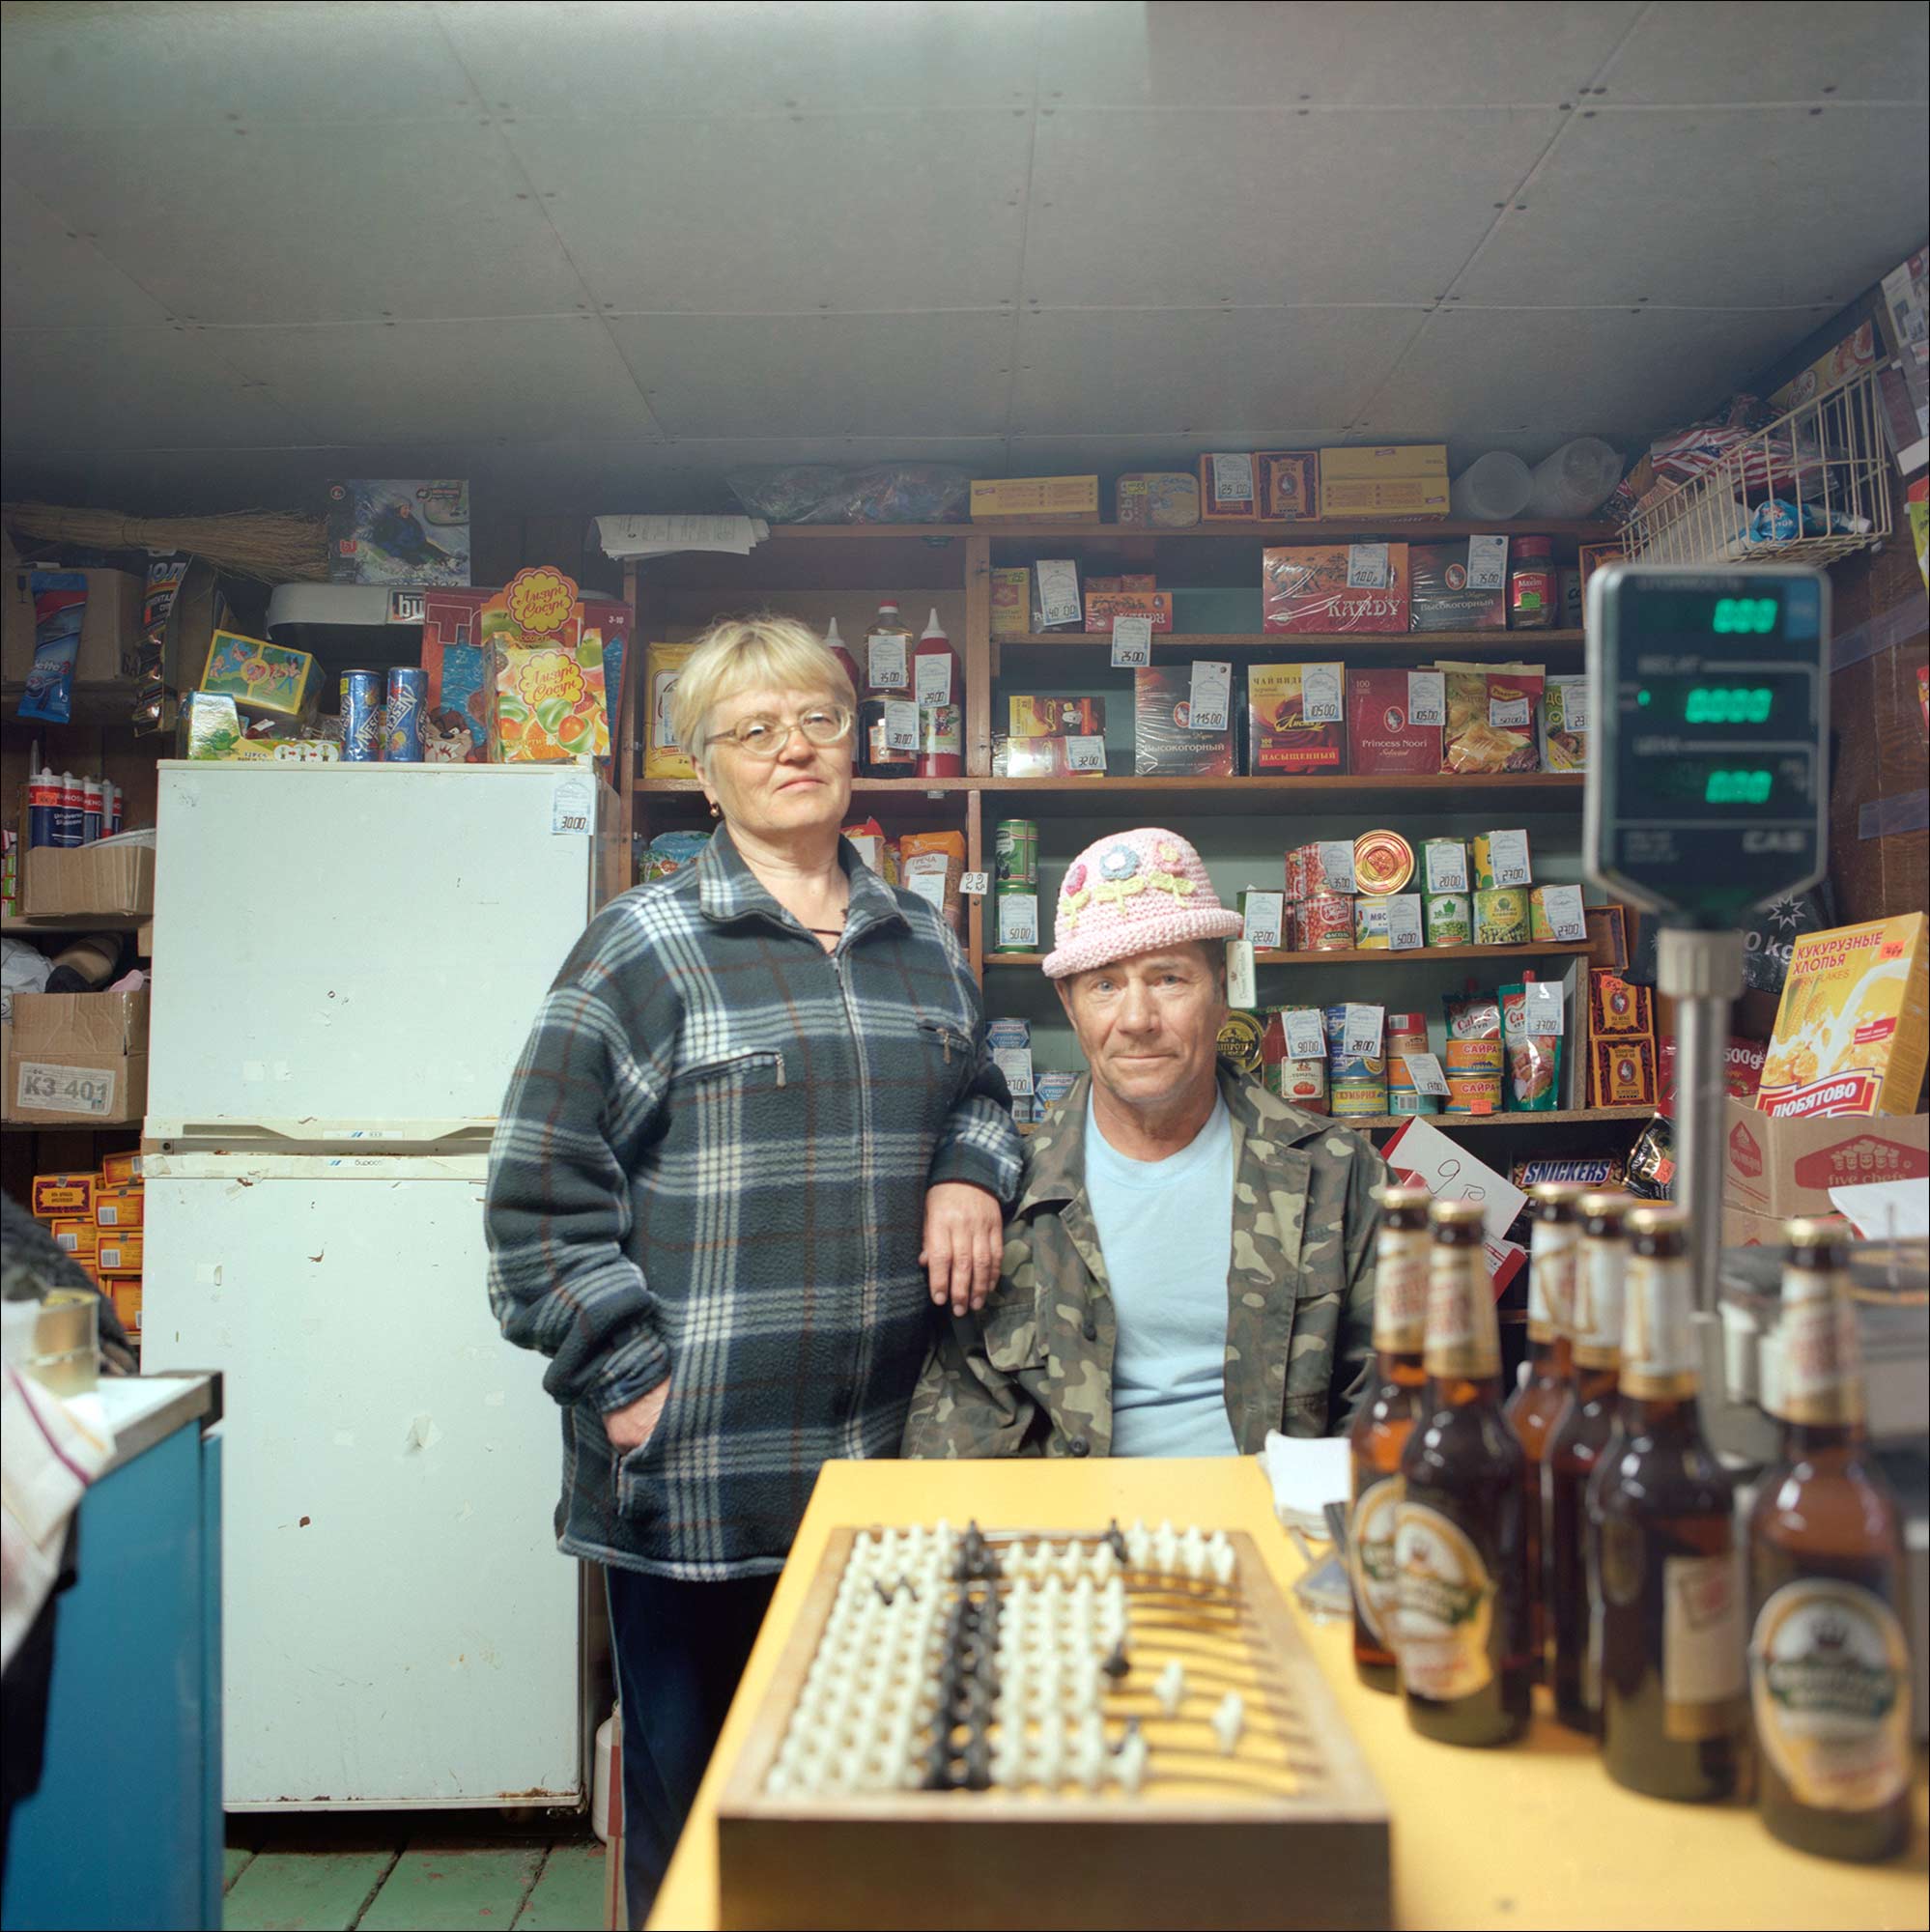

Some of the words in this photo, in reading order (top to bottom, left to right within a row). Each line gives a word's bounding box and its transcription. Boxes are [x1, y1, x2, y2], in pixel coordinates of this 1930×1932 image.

[398, 594, 424, 619] bu
[523, 599, 564, 619] Сосун
[1327, 599, 1402, 617] KANDY
[533, 680, 577, 701] Сосун
[1355, 680, 1371, 689] 100
[1361, 739, 1401, 749] Princess
[1402, 737, 1428, 749] Noori
[1261, 752, 1336, 761] НАСЫЩЕННЫЙ
[1370, 912, 1387, 921] МЯС
[1796, 932, 1884, 960] КУКУРУЗНЫЕ
[1792, 952, 1847, 976] ХЛОПЬЯ
[1462, 1043, 1498, 1053] САЙРА
[1461, 1082, 1496, 1093] САЙРА
[1772, 1081, 1858, 1117] ЛЮБЯТОВО
[1523, 1161, 1611, 1184] SNICKERS
